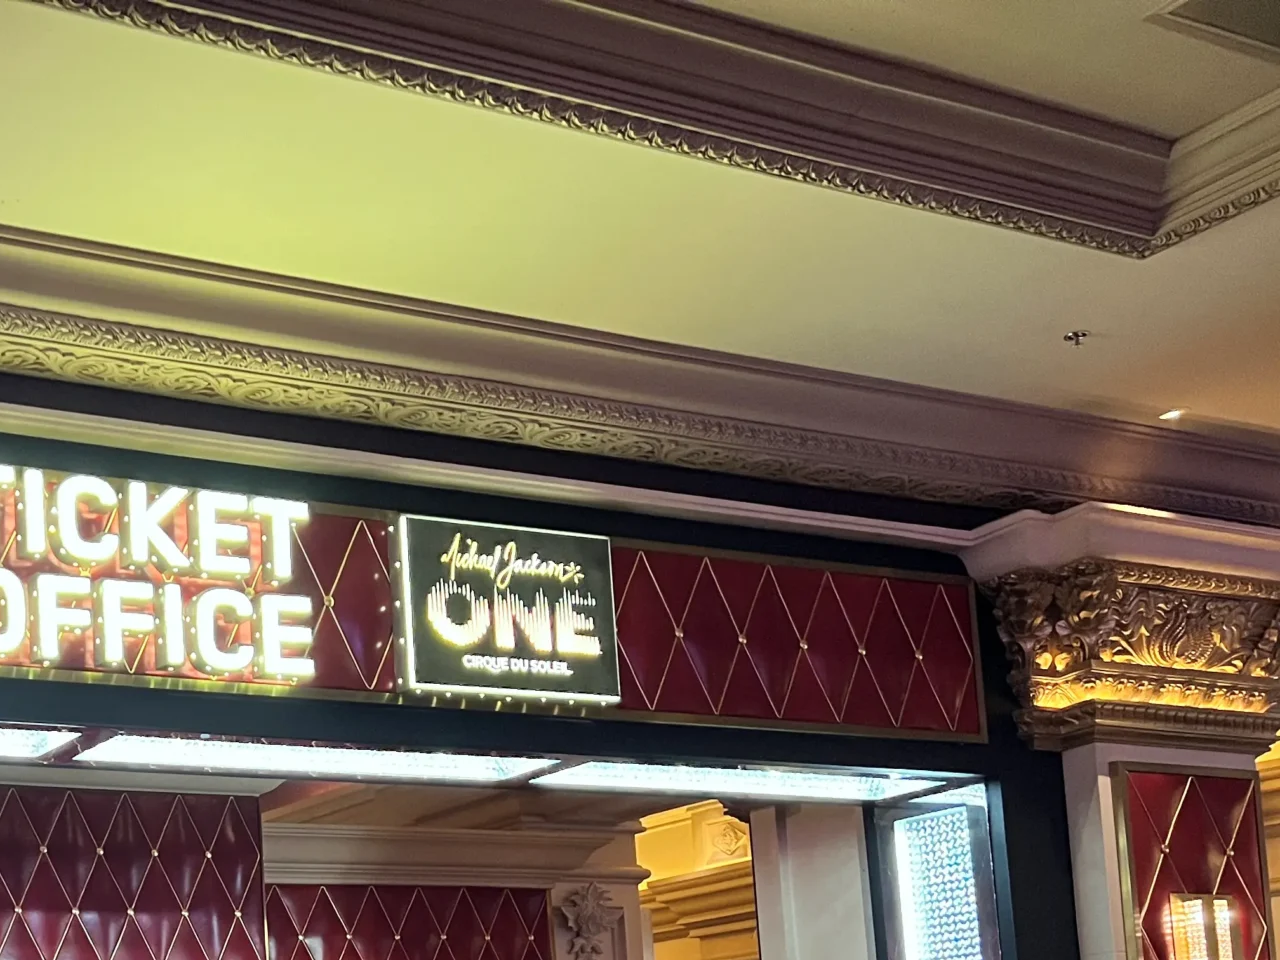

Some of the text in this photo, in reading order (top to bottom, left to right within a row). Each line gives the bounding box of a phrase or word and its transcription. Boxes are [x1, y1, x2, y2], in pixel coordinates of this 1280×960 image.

[426, 577, 603, 656] ONE
[462, 655, 572, 675] CIRQUE DU SOLEIL
